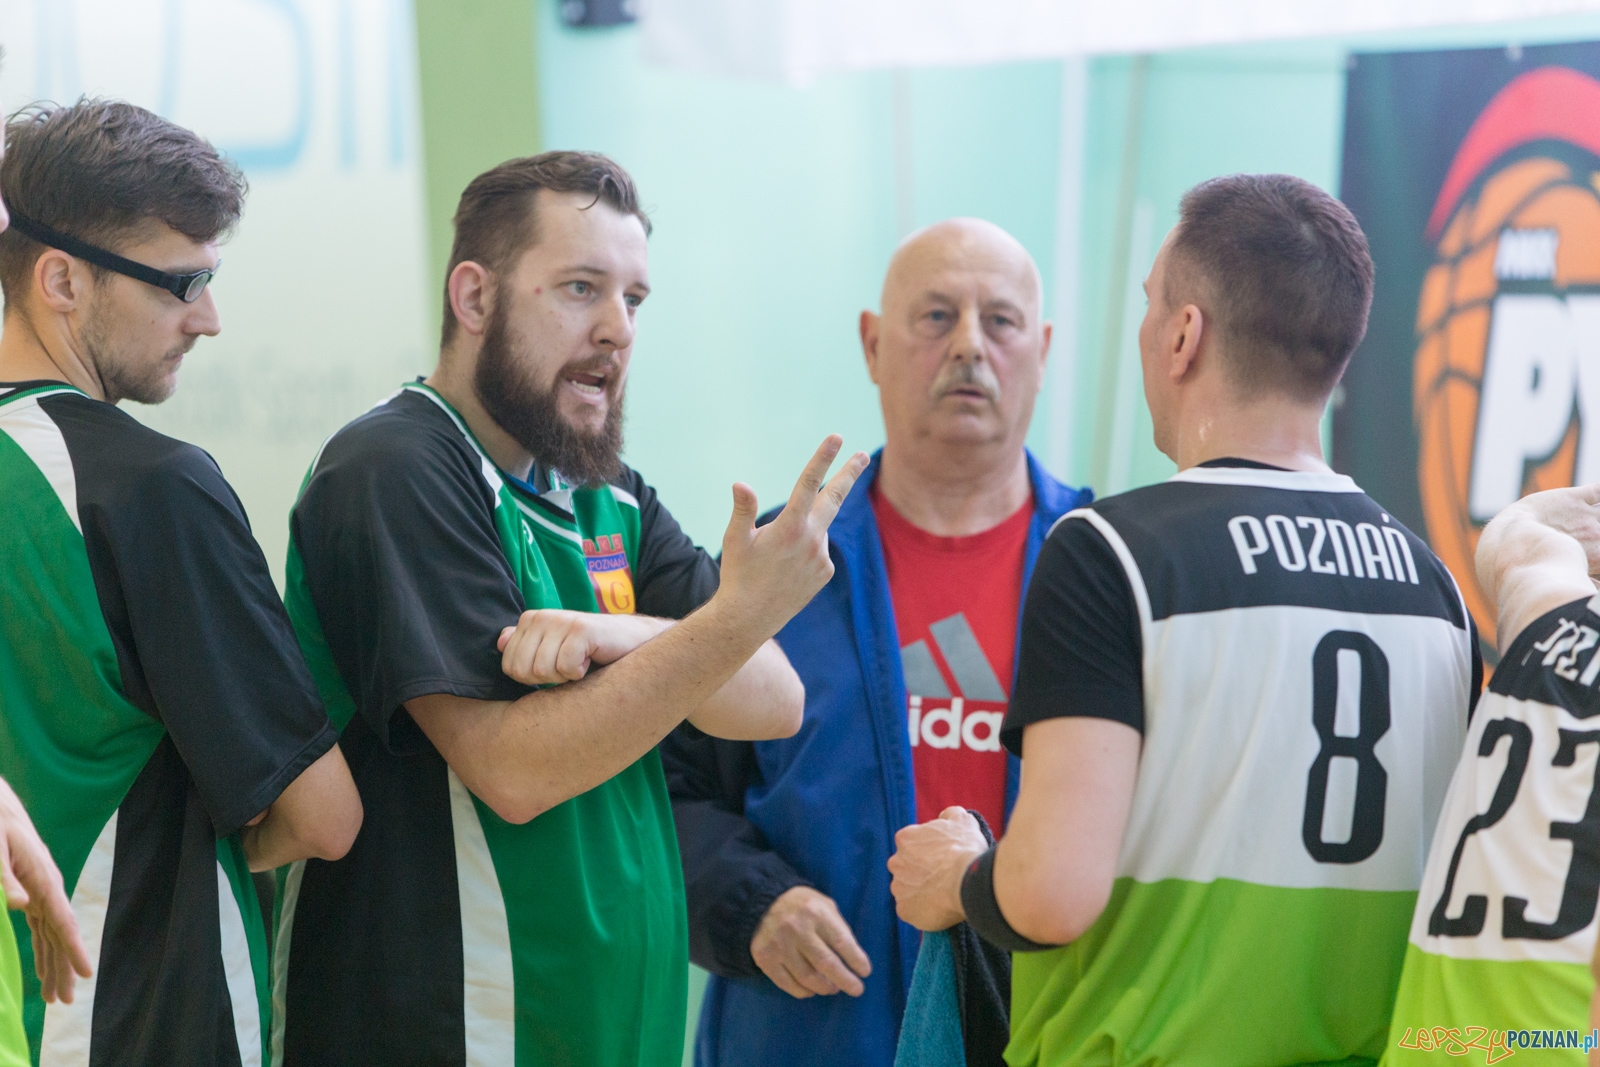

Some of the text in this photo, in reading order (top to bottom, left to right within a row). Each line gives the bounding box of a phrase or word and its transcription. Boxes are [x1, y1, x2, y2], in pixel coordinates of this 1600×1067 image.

[588, 555, 626, 571] POZNAŃ
[1228, 513, 1419, 585] POZNAŃ
[610, 581, 631, 611] G
[1302, 629, 1391, 864] 8
[1428, 716, 1600, 940] 23
